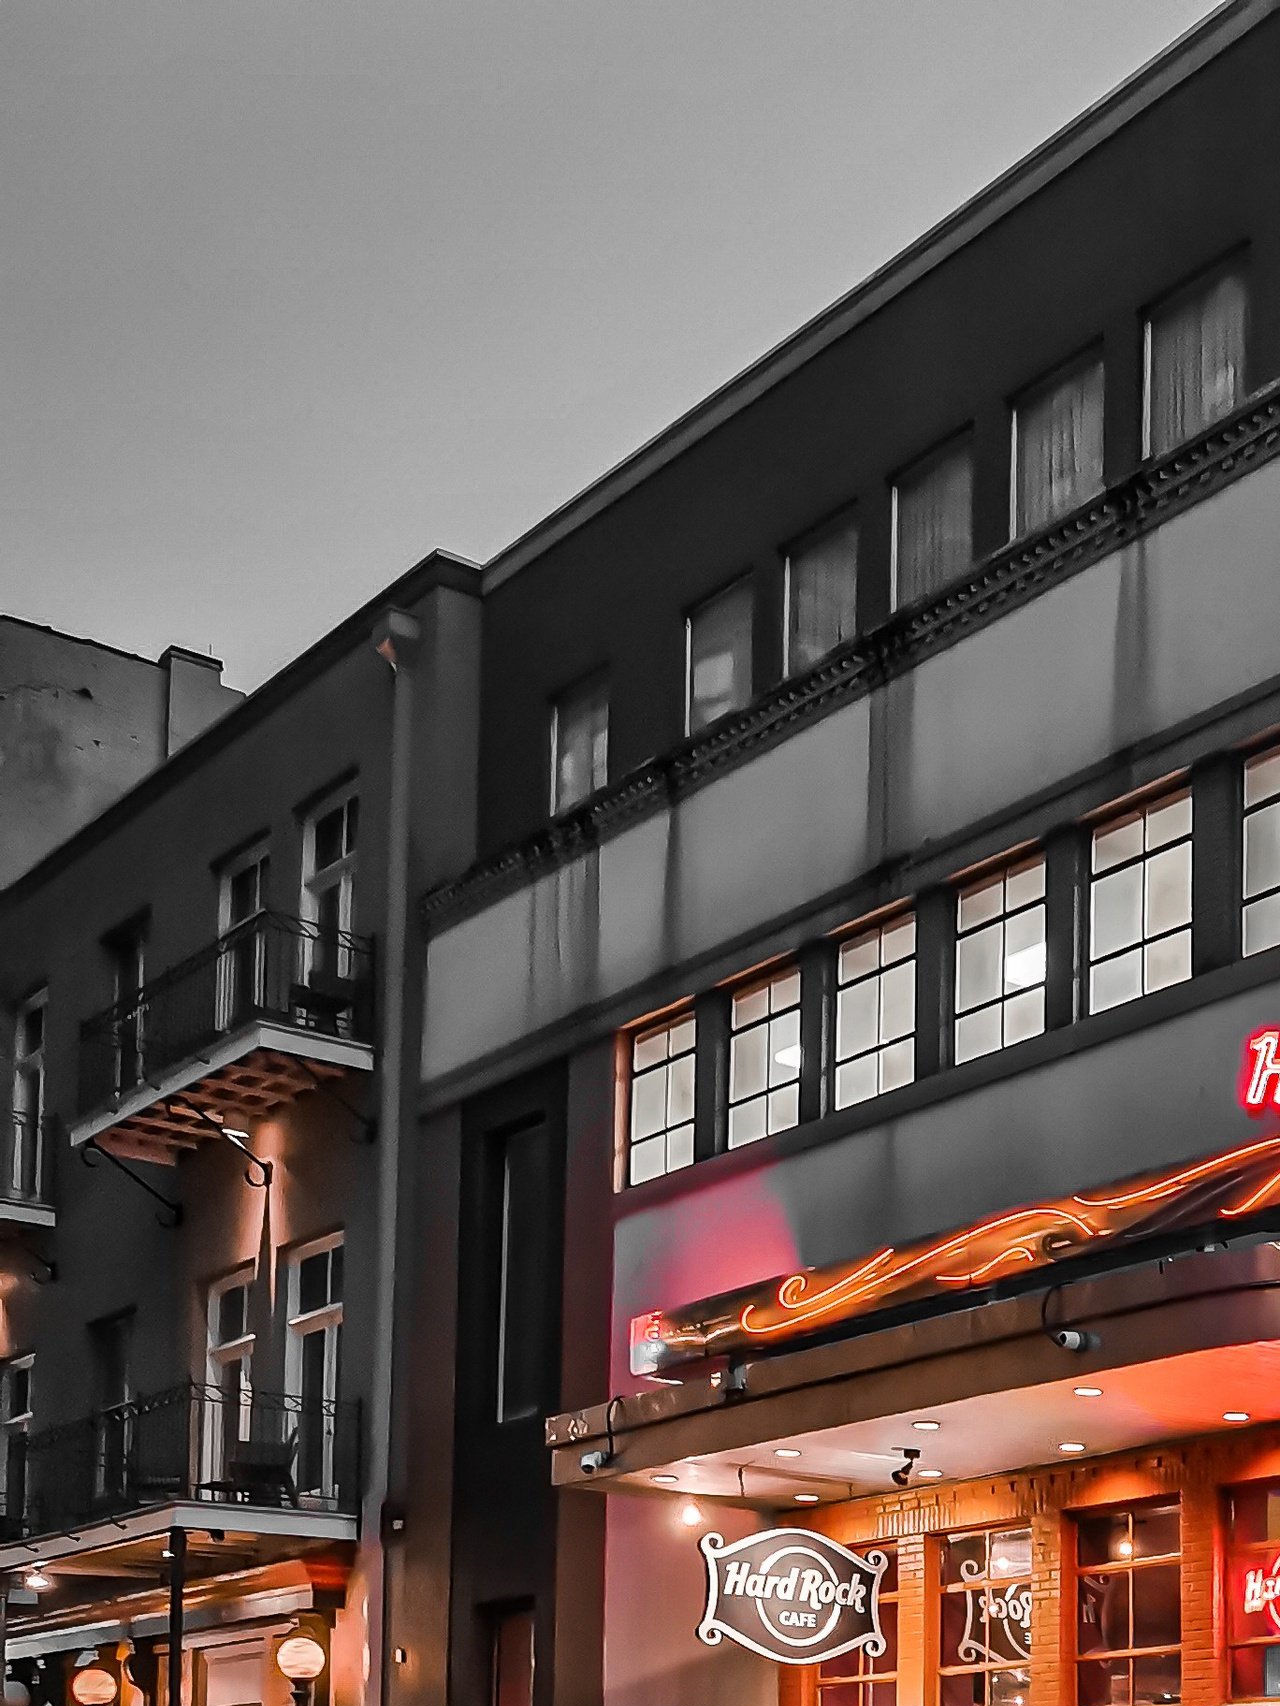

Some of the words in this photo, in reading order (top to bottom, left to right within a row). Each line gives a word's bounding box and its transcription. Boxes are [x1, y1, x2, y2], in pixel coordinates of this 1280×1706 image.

[723, 1561, 801, 1601] Hard
[797, 1567, 867, 1613] Rock
[778, 1609, 817, 1629] CAFE
